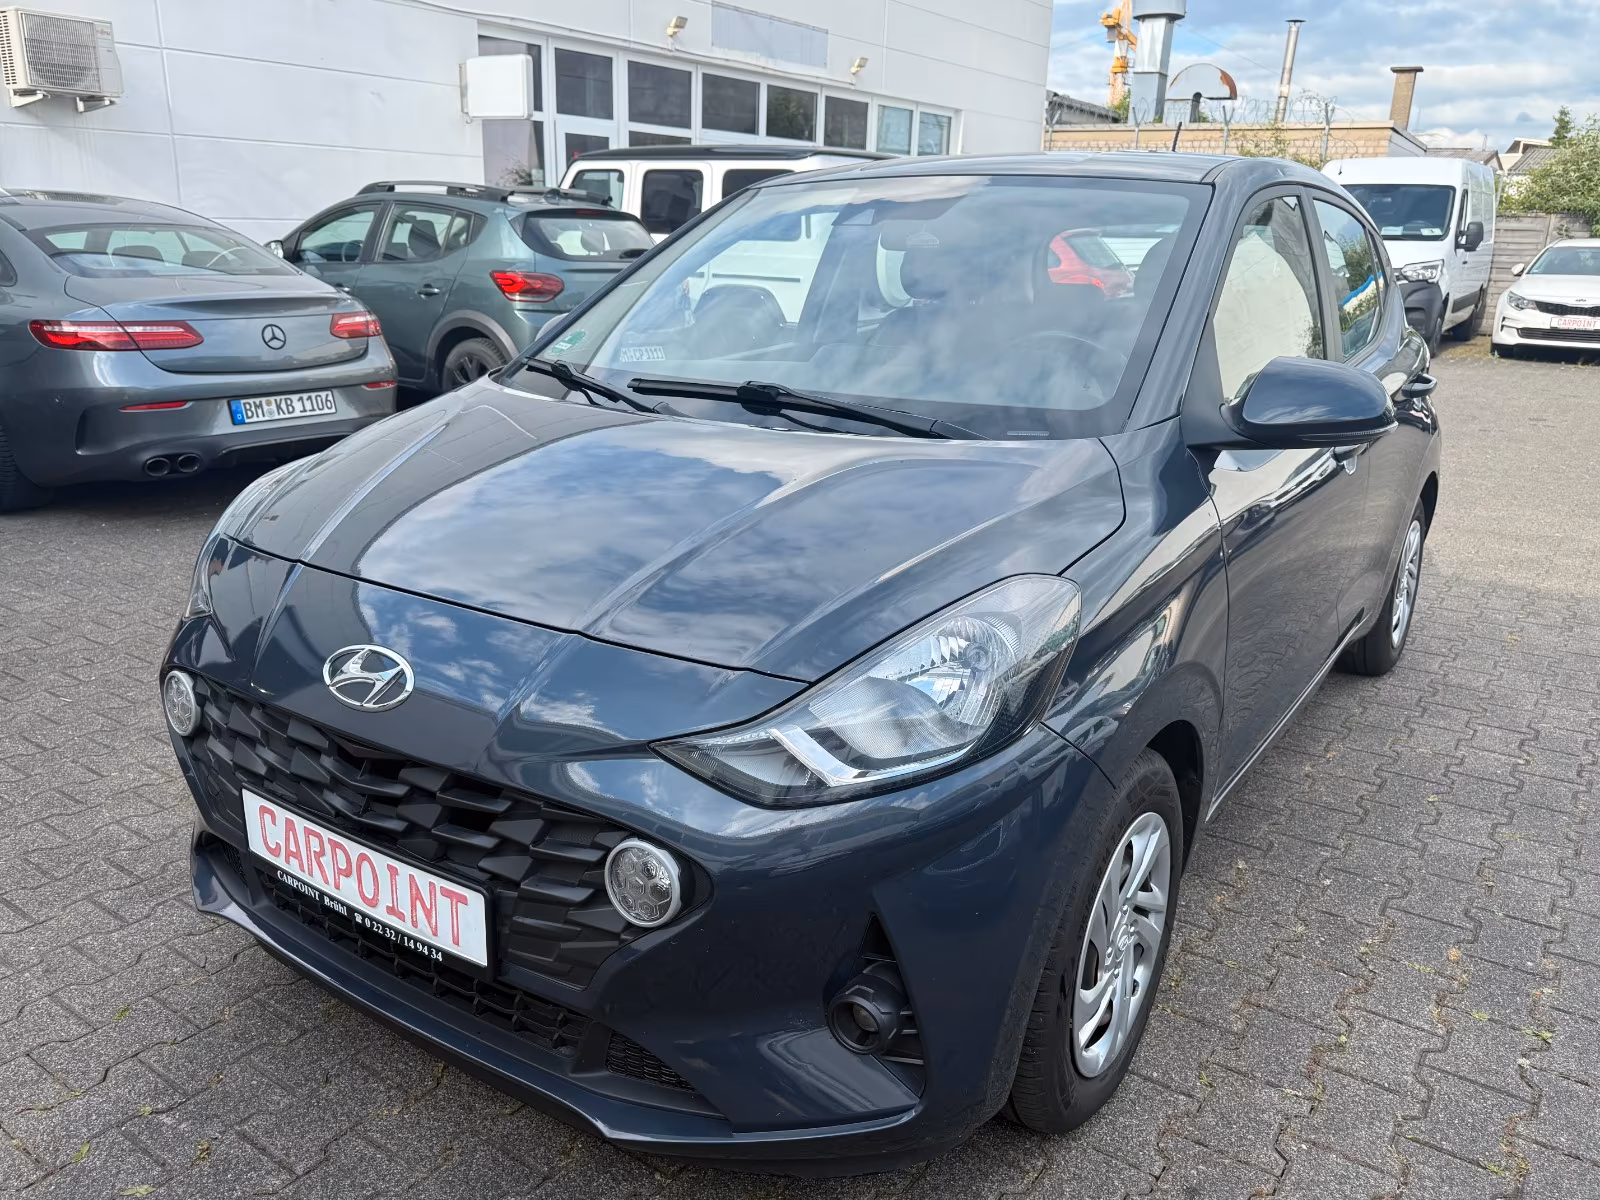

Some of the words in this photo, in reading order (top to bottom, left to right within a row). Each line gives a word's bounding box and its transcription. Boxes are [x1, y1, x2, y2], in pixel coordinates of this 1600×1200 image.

[1558, 318, 1596, 328] CARPOINT
[243, 400, 265, 420] BM
[274, 397, 296, 416] KB
[297, 393, 333, 413] 1106
[258, 804, 469, 947] CARPOINT
[277, 870, 320, 901] CARPOINT
[323, 895, 348, 917] Brühl
[364, 917, 371, 928] 0
[372, 921, 384, 935] 22
[384, 927, 396, 941] 32
[403, 936, 415, 950] 14
[416, 941, 429, 956] 94
[430, 948, 443, 962] 34
